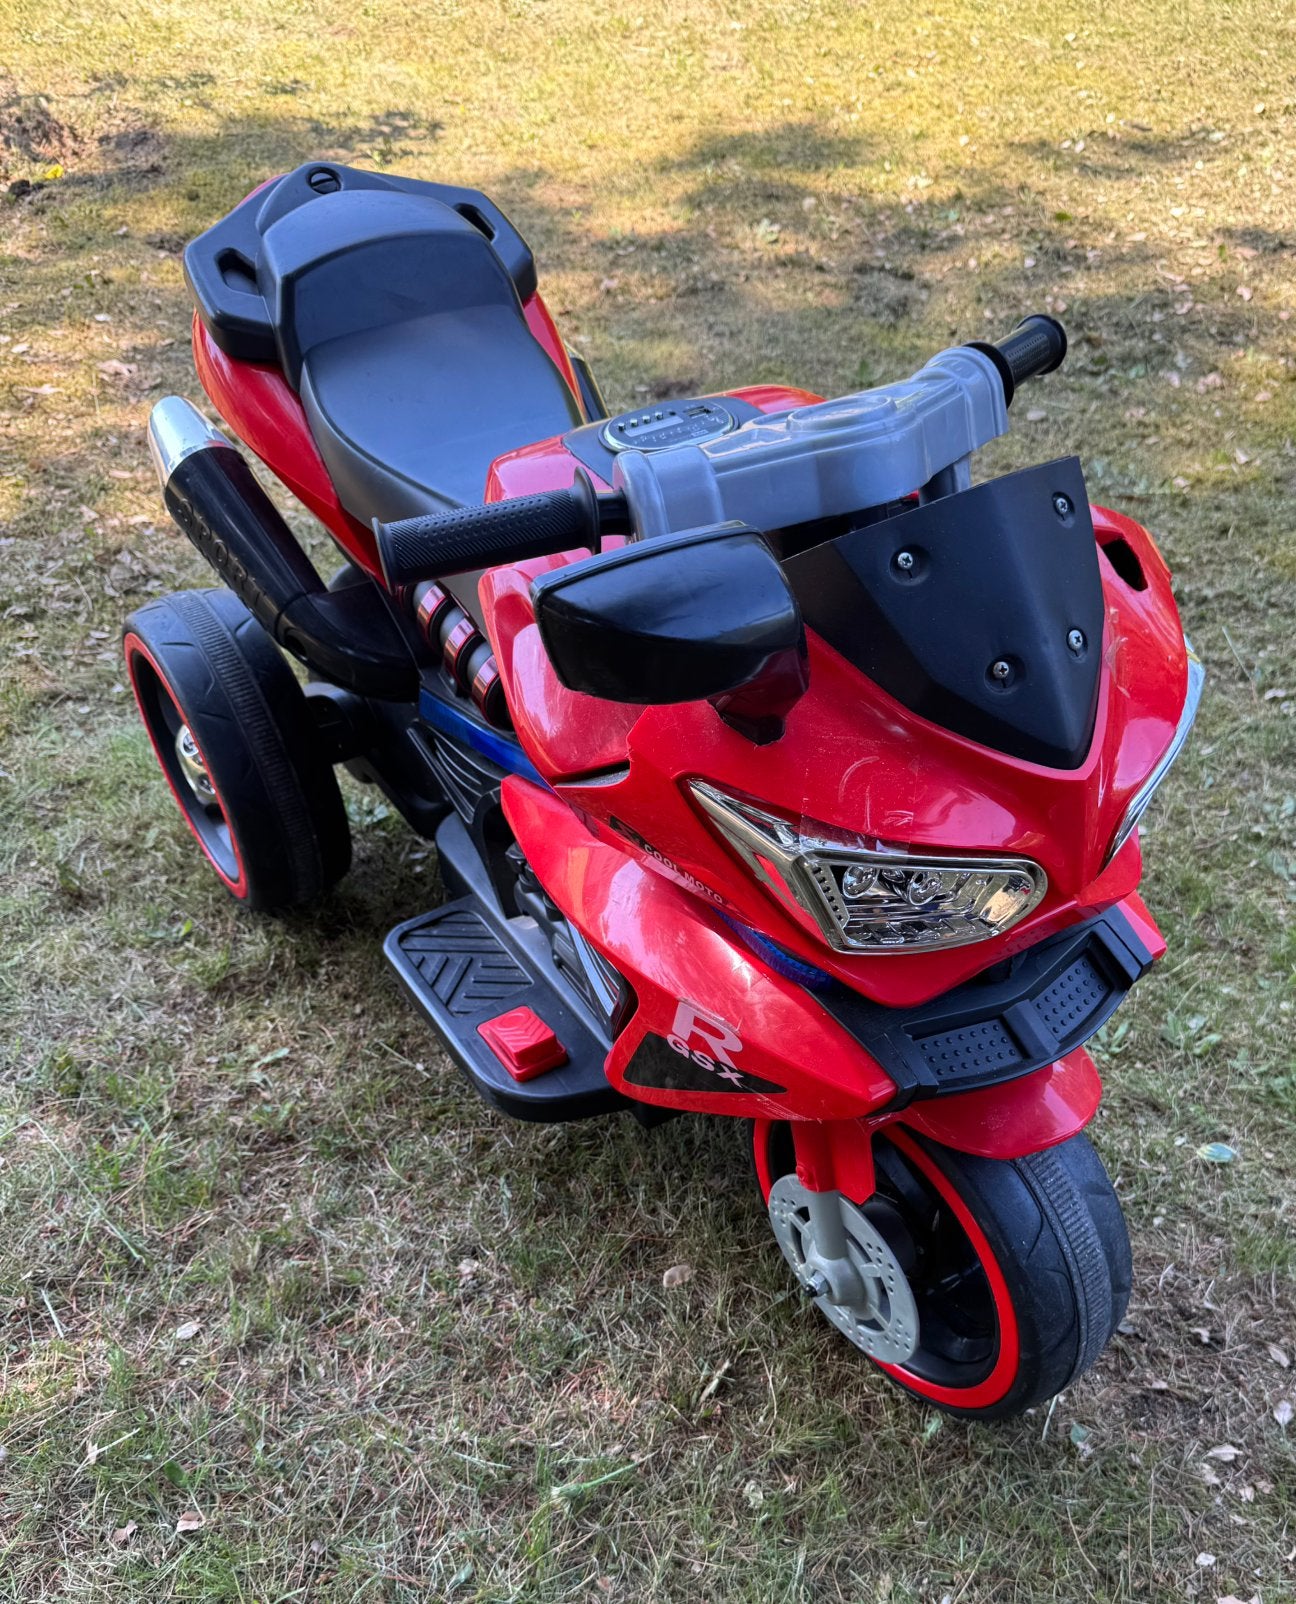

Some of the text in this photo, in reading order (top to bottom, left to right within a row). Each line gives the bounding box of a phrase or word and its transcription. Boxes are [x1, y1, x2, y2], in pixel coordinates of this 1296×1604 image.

[644, 844, 724, 905] COOL MOTO
[666, 1033, 745, 1087] GSX
[671, 1002, 744, 1070] R
